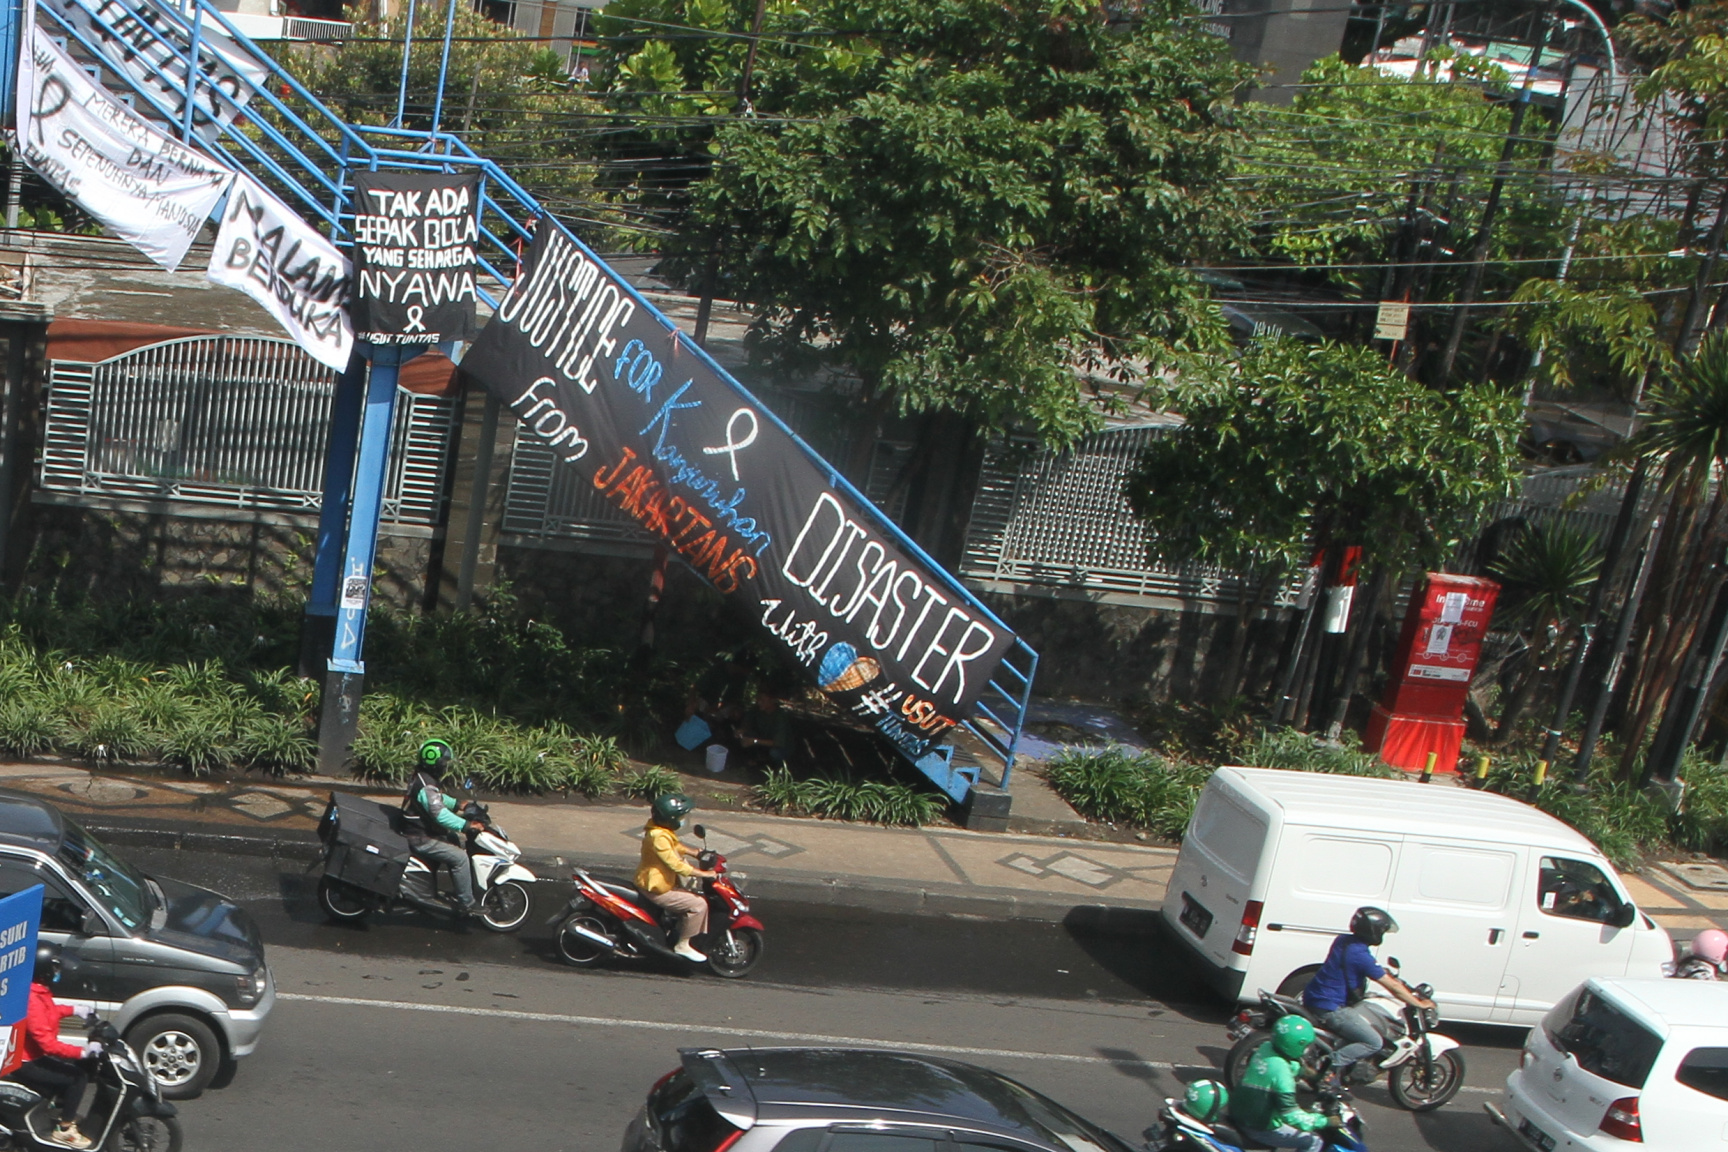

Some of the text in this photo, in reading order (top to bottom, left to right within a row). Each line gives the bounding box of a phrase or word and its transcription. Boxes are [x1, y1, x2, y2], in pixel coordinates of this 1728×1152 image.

[83, 92, 149, 147] MEREKA
[58, 129, 203, 238] SEPENUHNYA MANUSIA
[127, 148, 170, 186] DAN
[368, 187, 469, 217] TAK ADA
[355, 215, 478, 249] SEPAK BOLA
[363, 246, 476, 269] YANG SEHARGA
[359, 270, 477, 307] NYAWA
[396, 333, 440, 344] TUNTAS
[498, 228, 635, 394] JUSTICE
[782, 490, 995, 704] DISASTER
